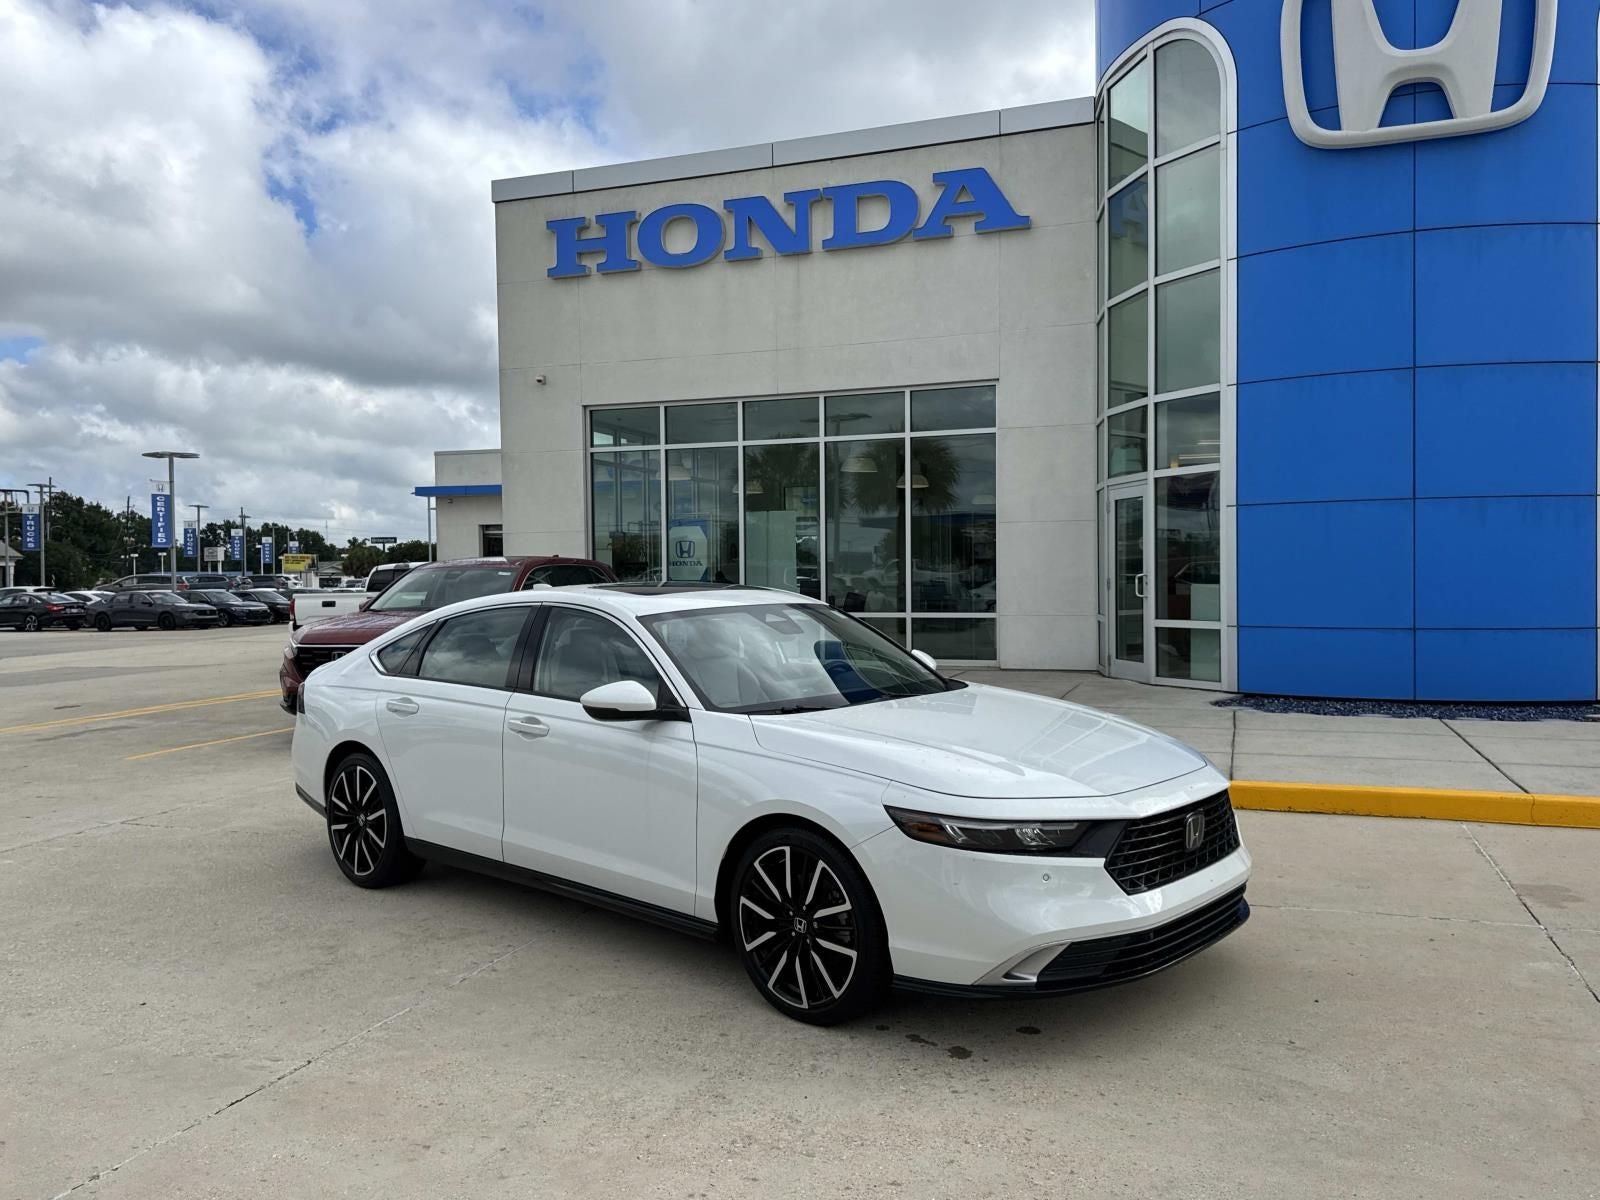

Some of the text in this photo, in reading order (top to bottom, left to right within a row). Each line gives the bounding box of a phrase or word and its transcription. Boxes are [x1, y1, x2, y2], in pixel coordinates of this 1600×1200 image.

[546, 167, 1031, 279] HONDA
[26, 514, 35, 548] TRUCKS
[156, 496, 167, 543] CERTIFIED
[186, 528, 194, 555] TRUCKS
